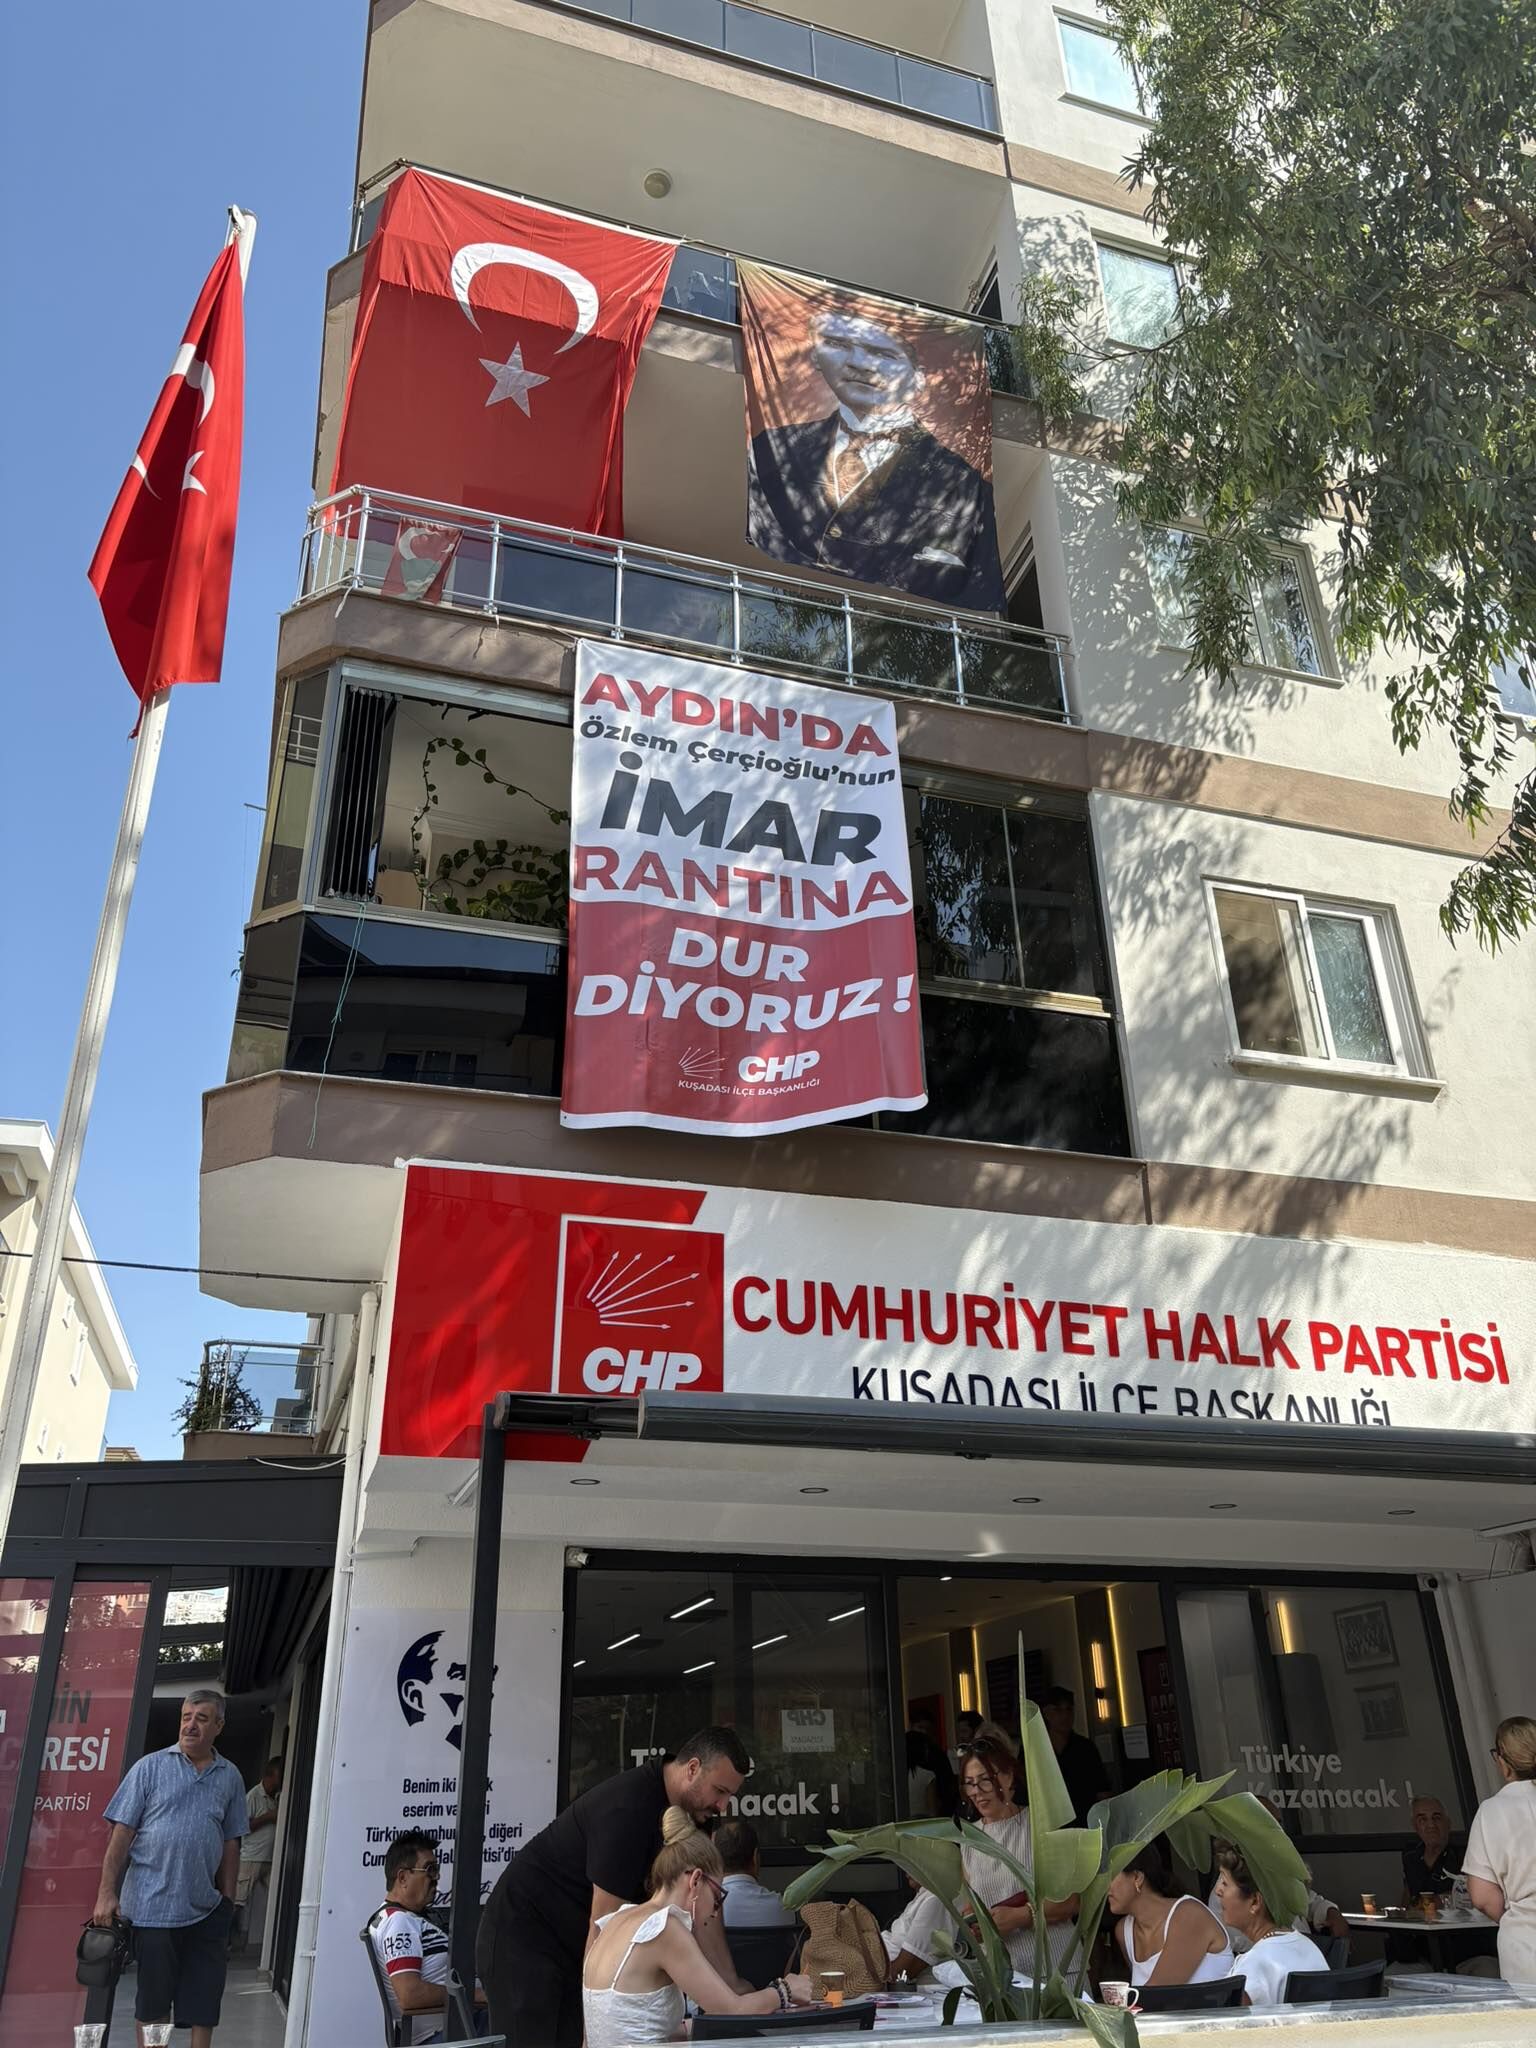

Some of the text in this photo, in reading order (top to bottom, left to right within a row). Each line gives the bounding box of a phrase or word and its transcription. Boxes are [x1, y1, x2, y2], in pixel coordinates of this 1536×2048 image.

[580, 715, 678, 754] Özlem
[600, 751, 882, 866] İMAR
[573, 845, 909, 921] RANTINA
[667, 927, 809, 982] DUR
[738, 1050, 820, 1083] CHP
[678, 1078, 821, 1097] KUŞADASI İLÇE BAŞKANLIĞI
[732, 1276, 1510, 1385] CUMHURİYET HALK PARTİSİ
[582, 1347, 702, 1394] CHP
[1240, 1744, 1342, 1782] Türkiye
[33, 1792, 92, 1811] PARTİSİ
[402, 1777, 457, 1793] Benim iki
[1248, 1778, 1400, 1809] Kazanacak
[402, 1802, 444, 1817] eserim
[489, 1823, 523, 1843] diğeri
